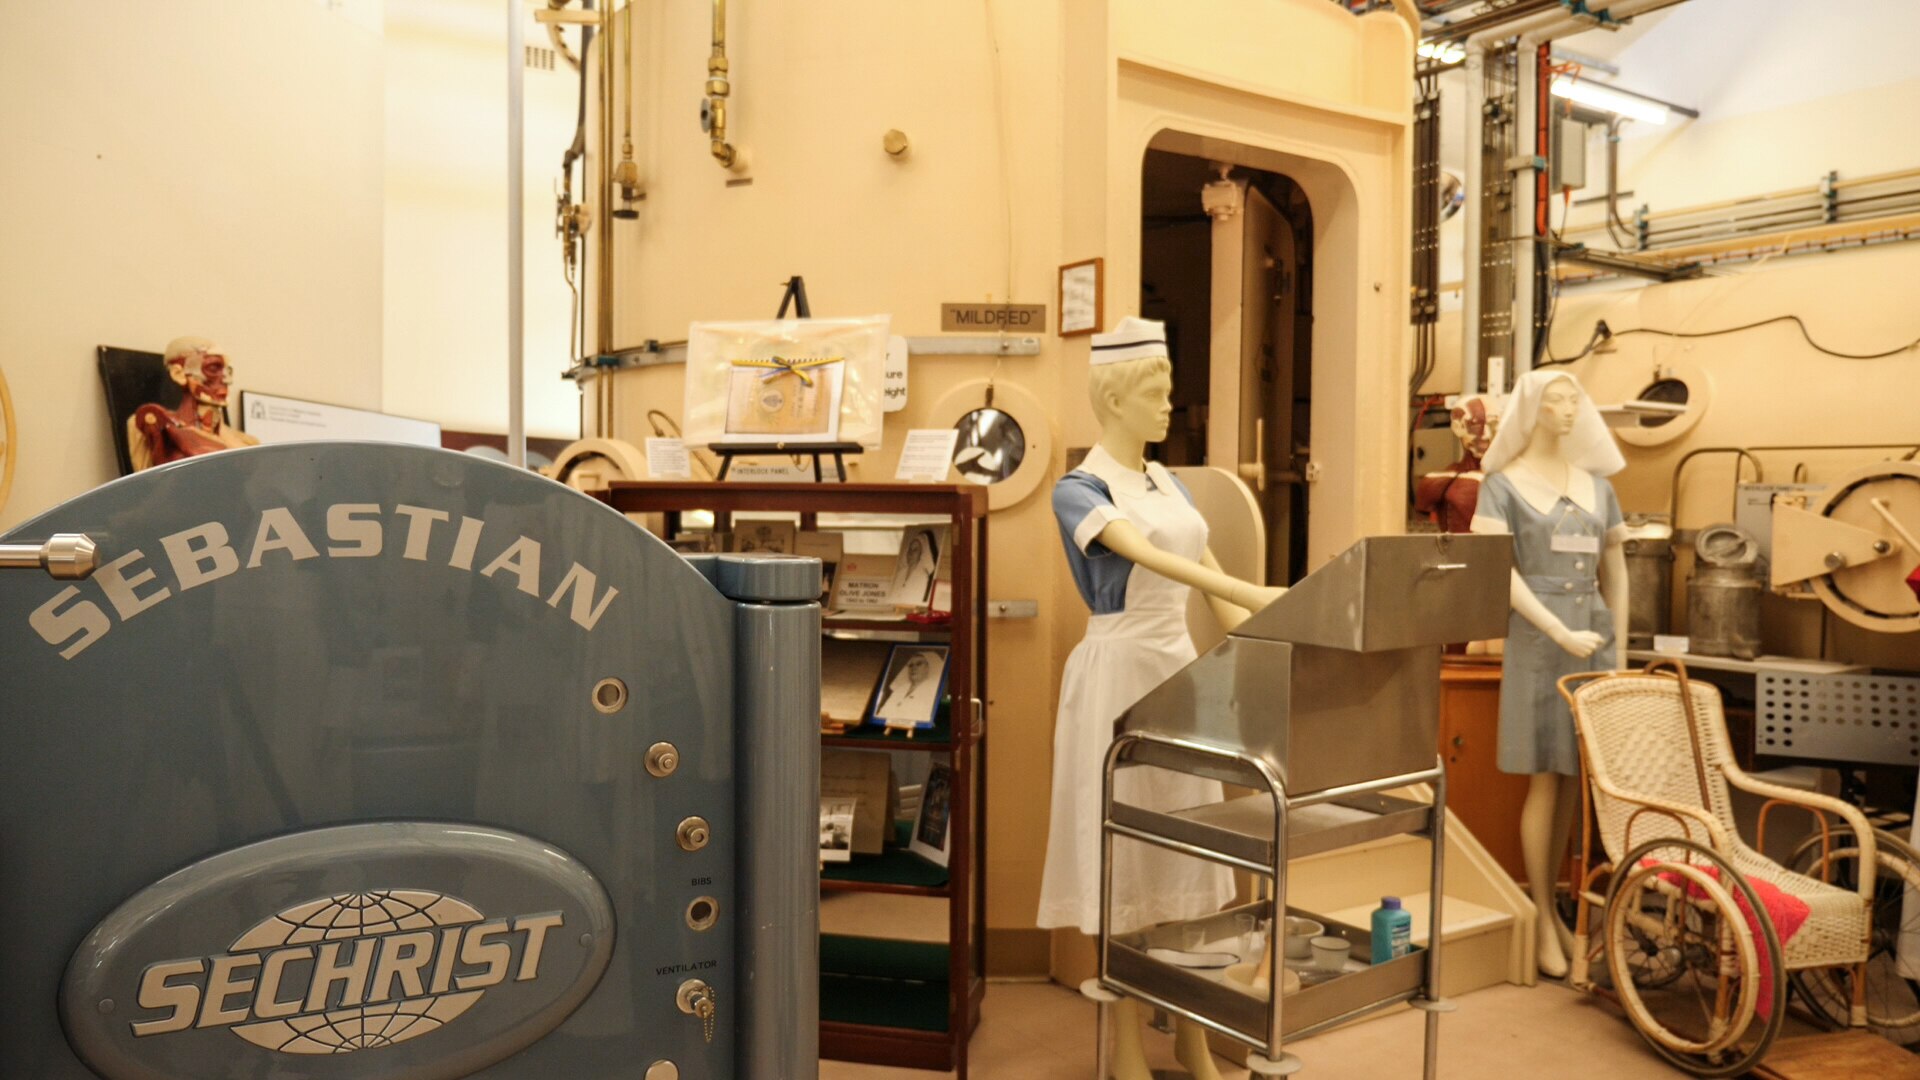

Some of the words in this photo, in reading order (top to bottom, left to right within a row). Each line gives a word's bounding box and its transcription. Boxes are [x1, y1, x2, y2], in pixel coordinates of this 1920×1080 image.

[770, 467, 789, 475] PANEL
[28, 503, 620, 661] SEBASTIAN
[691, 877, 712, 886] BIBS
[130, 910, 565, 1037] SECHRIST
[656, 959, 718, 975] VENTILATOR
